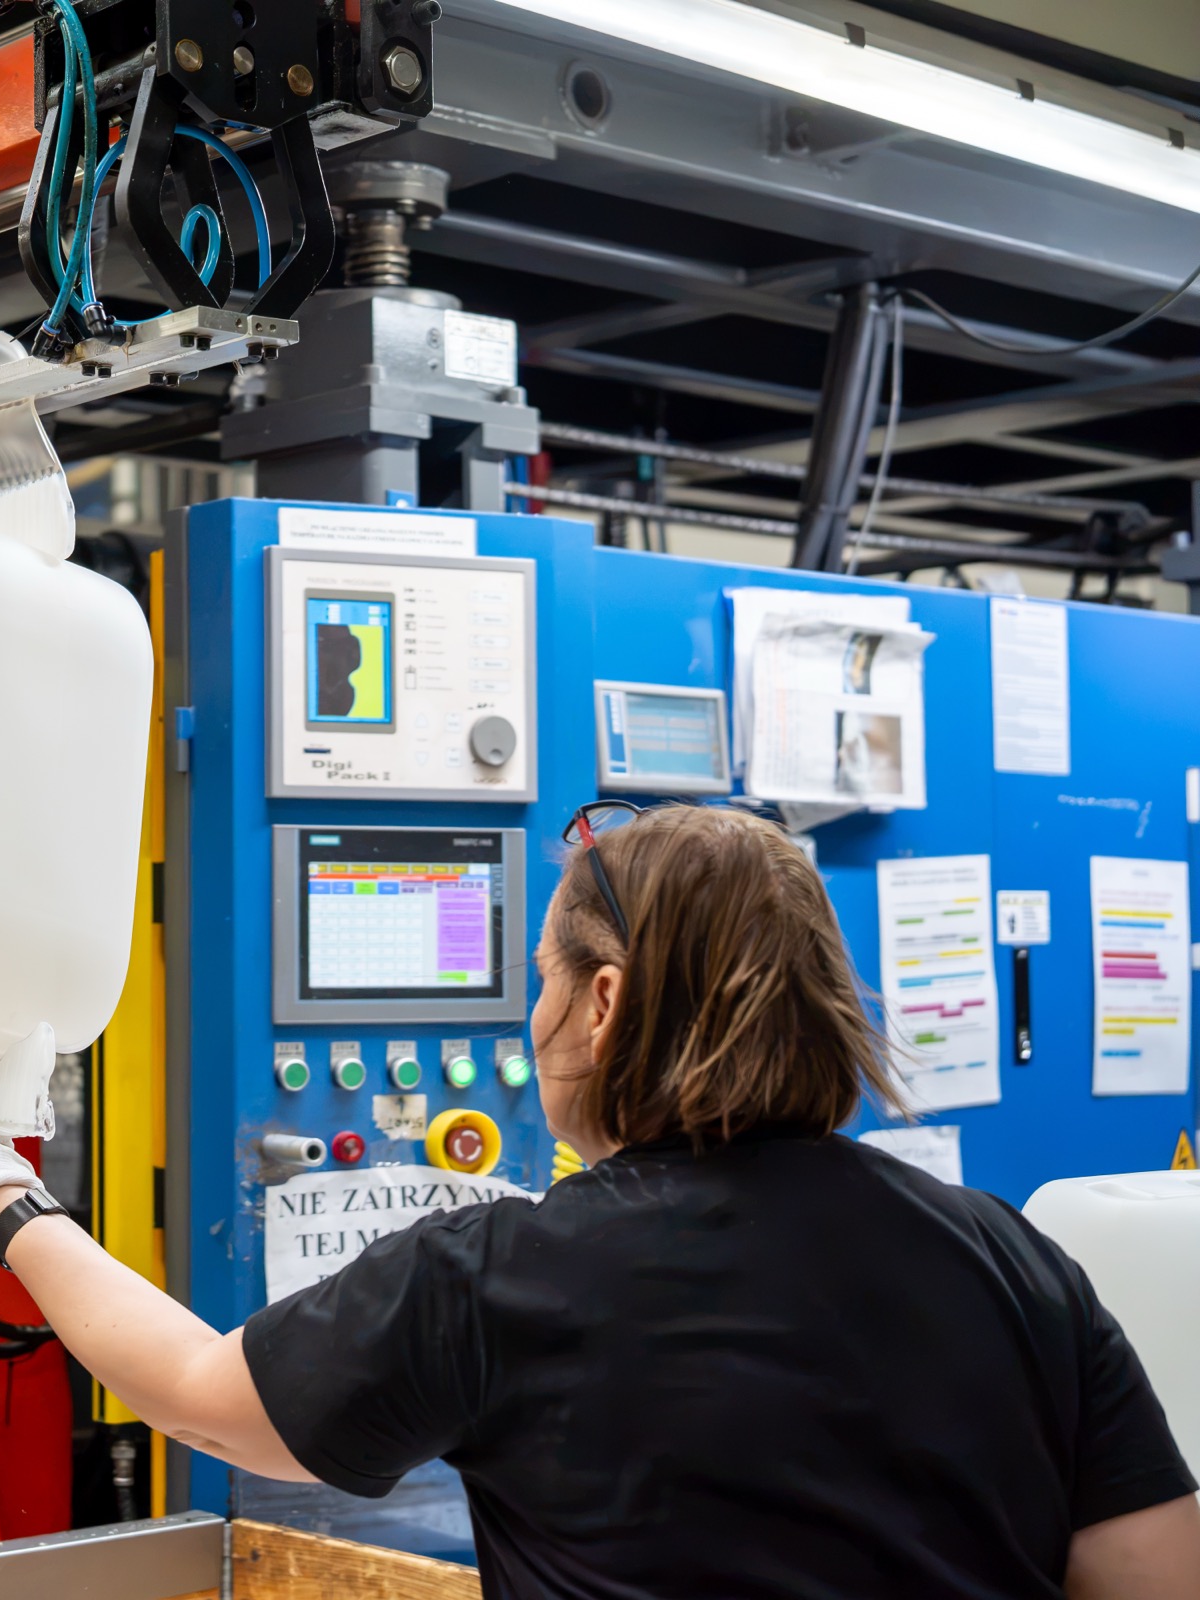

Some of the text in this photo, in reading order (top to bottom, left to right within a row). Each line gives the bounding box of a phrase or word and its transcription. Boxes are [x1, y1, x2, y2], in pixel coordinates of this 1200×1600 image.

[278, 1183, 518, 1218] NIE ZATRZYM
[295, 1231, 346, 1257] TEJ
